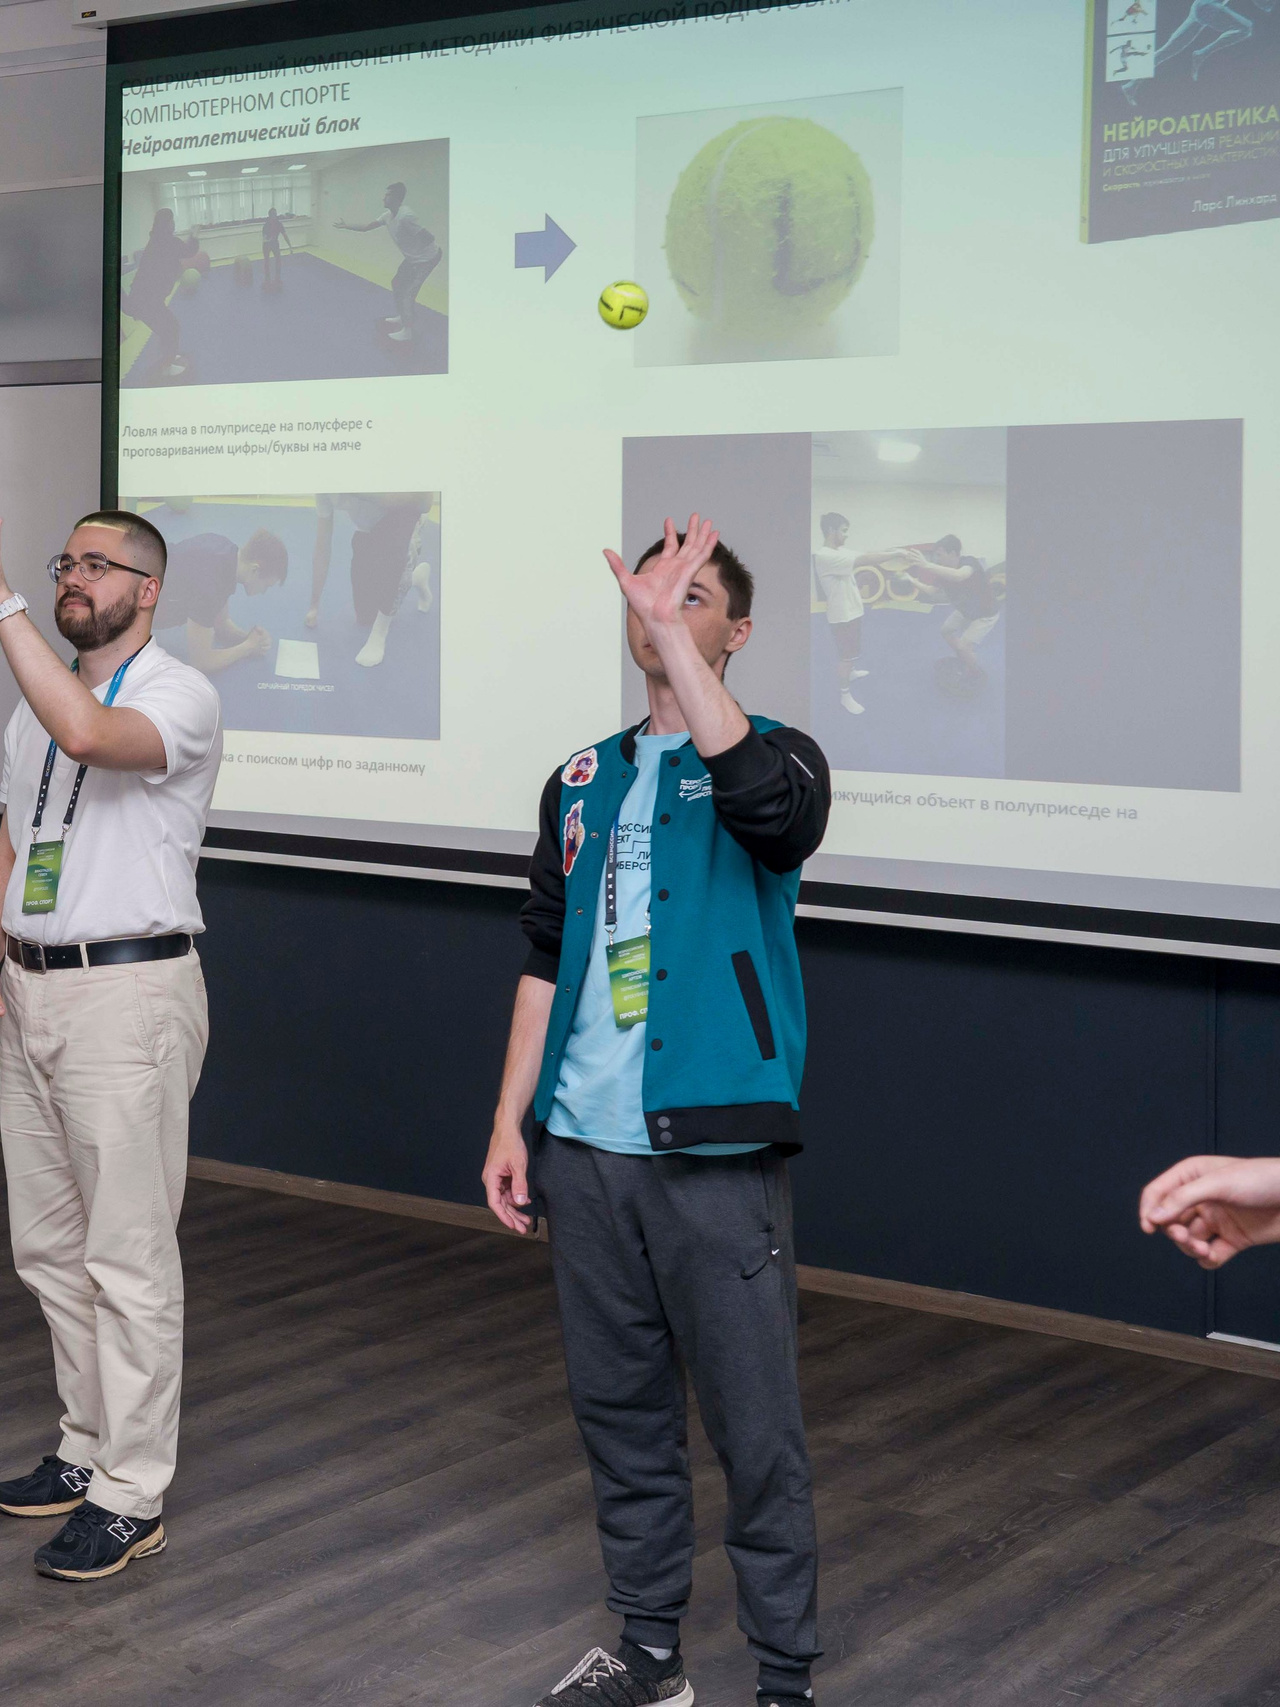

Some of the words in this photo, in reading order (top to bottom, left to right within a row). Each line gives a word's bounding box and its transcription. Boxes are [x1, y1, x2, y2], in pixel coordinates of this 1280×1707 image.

[293, 41, 416, 77] КОМПОНЕНТ
[420, 23, 535, 60] МЕТОДИКИ
[541, 3, 687, 43] ФИЗИЧЕСКОЙ
[280, 82, 351, 108] СПОРТЕ
[121, 116, 311, 156] Нейроатлетический
[315, 115, 361, 136] блок
[1103, 104, 1280, 143] НЕЙРОАТЛЕТИКА
[1103, 147, 1130, 163] ДЛЯ
[1134, 136, 1215, 159] УЛУЧШЕНИЯ
[1191, 200, 1223, 213] Ларс
[122, 424, 158, 438] Ловля
[160, 423, 188, 437] мяча
[191, 424, 198, 435] в
[200, 420, 277, 438] полуприседе
[279, 420, 294, 432] на
[297, 417, 363, 434] полусфере
[366, 418, 373, 429] с
[122, 443, 224, 459] проговариванием
[227, 438, 310, 456] цифры/буквы
[312, 440, 327, 452] на
[330, 439, 362, 452] мяче
[237, 755, 244, 763] с
[246, 753, 298, 767] поиском
[301, 755, 334, 771] цифр
[336, 758, 353, 769] по
[355, 759, 426, 777] заданному
[916, 792, 976, 811] объект
[980, 800, 990, 810] в
[994, 799, 1112, 821] полуприседе
[1116, 806, 1138, 820] на
